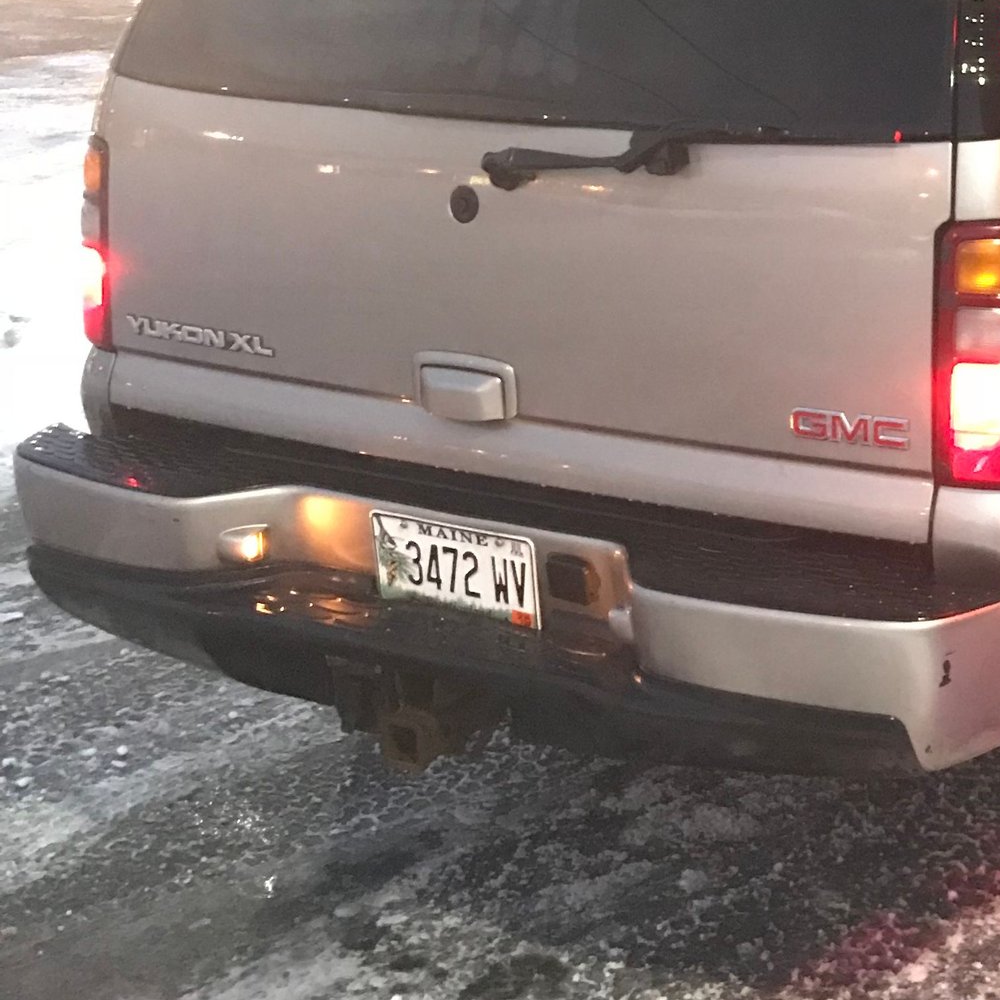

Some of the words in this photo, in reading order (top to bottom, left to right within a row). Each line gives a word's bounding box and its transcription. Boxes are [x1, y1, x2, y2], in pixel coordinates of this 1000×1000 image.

[126, 315, 225, 348] YUKON
[229, 331, 275, 357] XL
[790, 407, 910, 450] GMC
[418, 523, 489, 547] MAINE
[405, 540, 481, 599] 3472
[491, 555, 526, 608] WV
